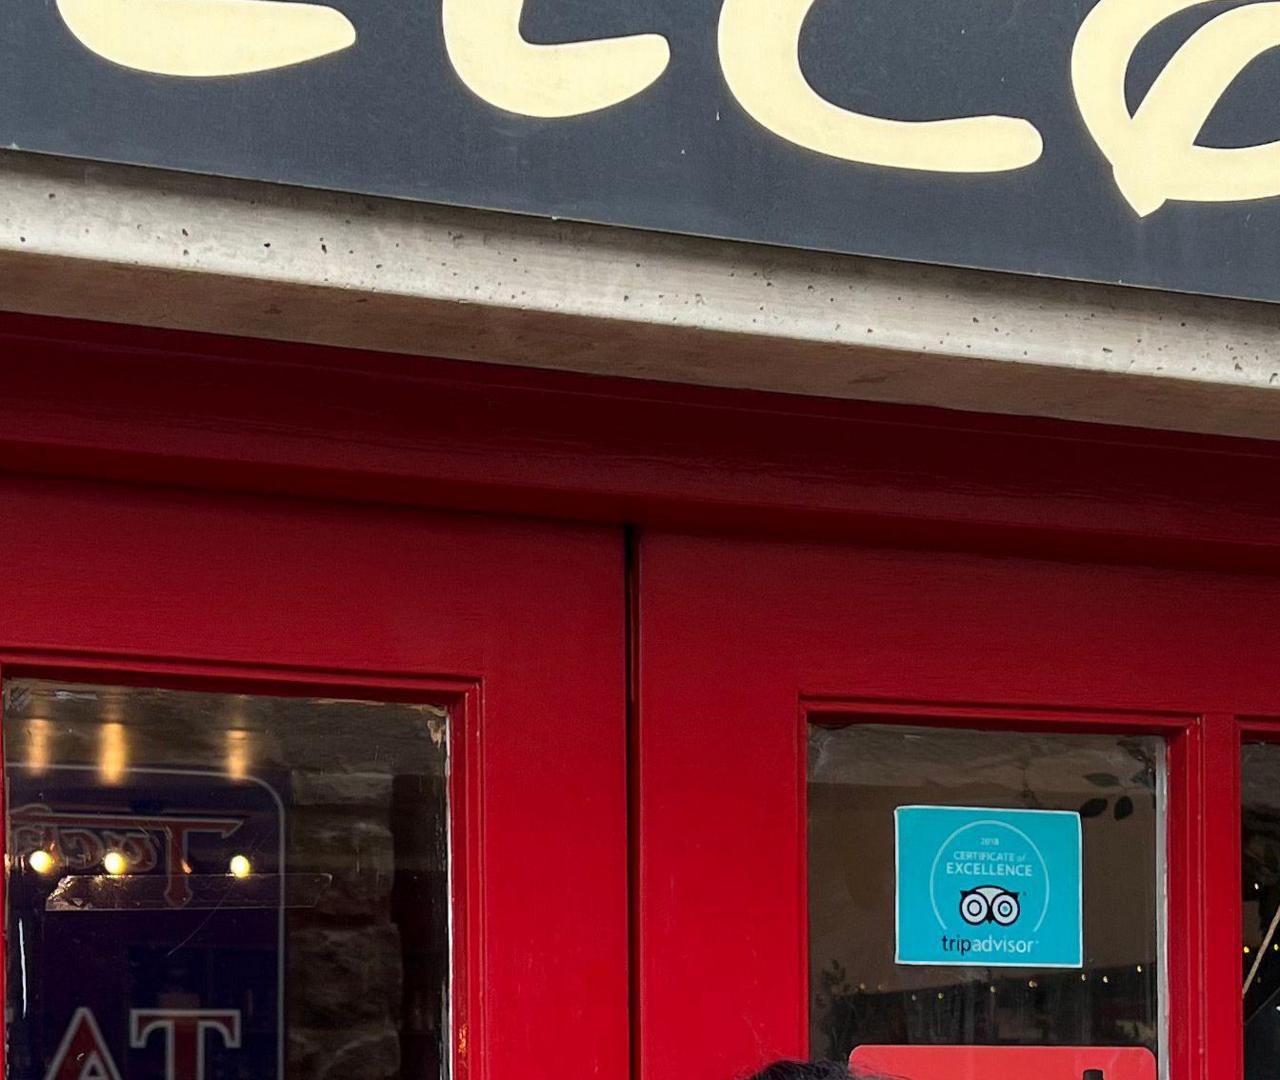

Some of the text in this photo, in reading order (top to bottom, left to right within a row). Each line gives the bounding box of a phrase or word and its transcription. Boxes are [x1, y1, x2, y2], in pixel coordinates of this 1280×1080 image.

[953, 851, 1014, 862] CERTIFICATE
[946, 862, 1033, 877] EXCELLENCE
[942, 935, 1034, 956] tripadvisor
